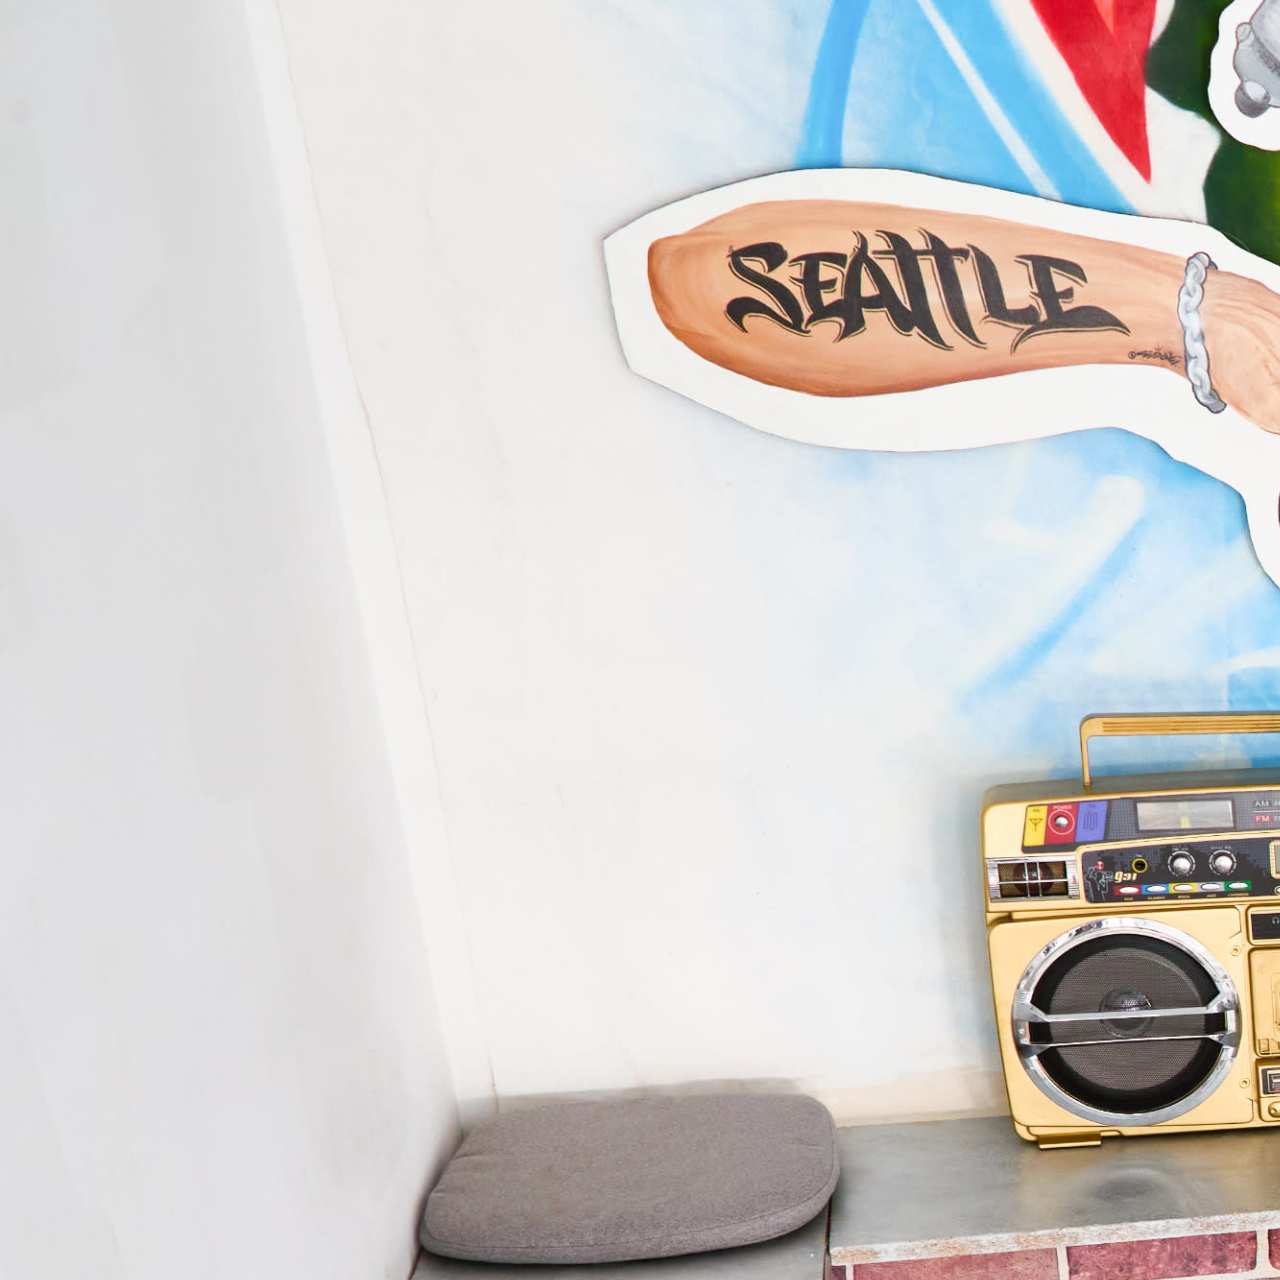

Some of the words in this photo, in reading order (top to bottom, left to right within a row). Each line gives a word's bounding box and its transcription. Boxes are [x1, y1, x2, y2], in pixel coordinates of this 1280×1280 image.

[723, 226, 1131, 354] SEATTLE
[1254, 800, 1270, 808] AM
[1255, 815, 1271, 823] FM
